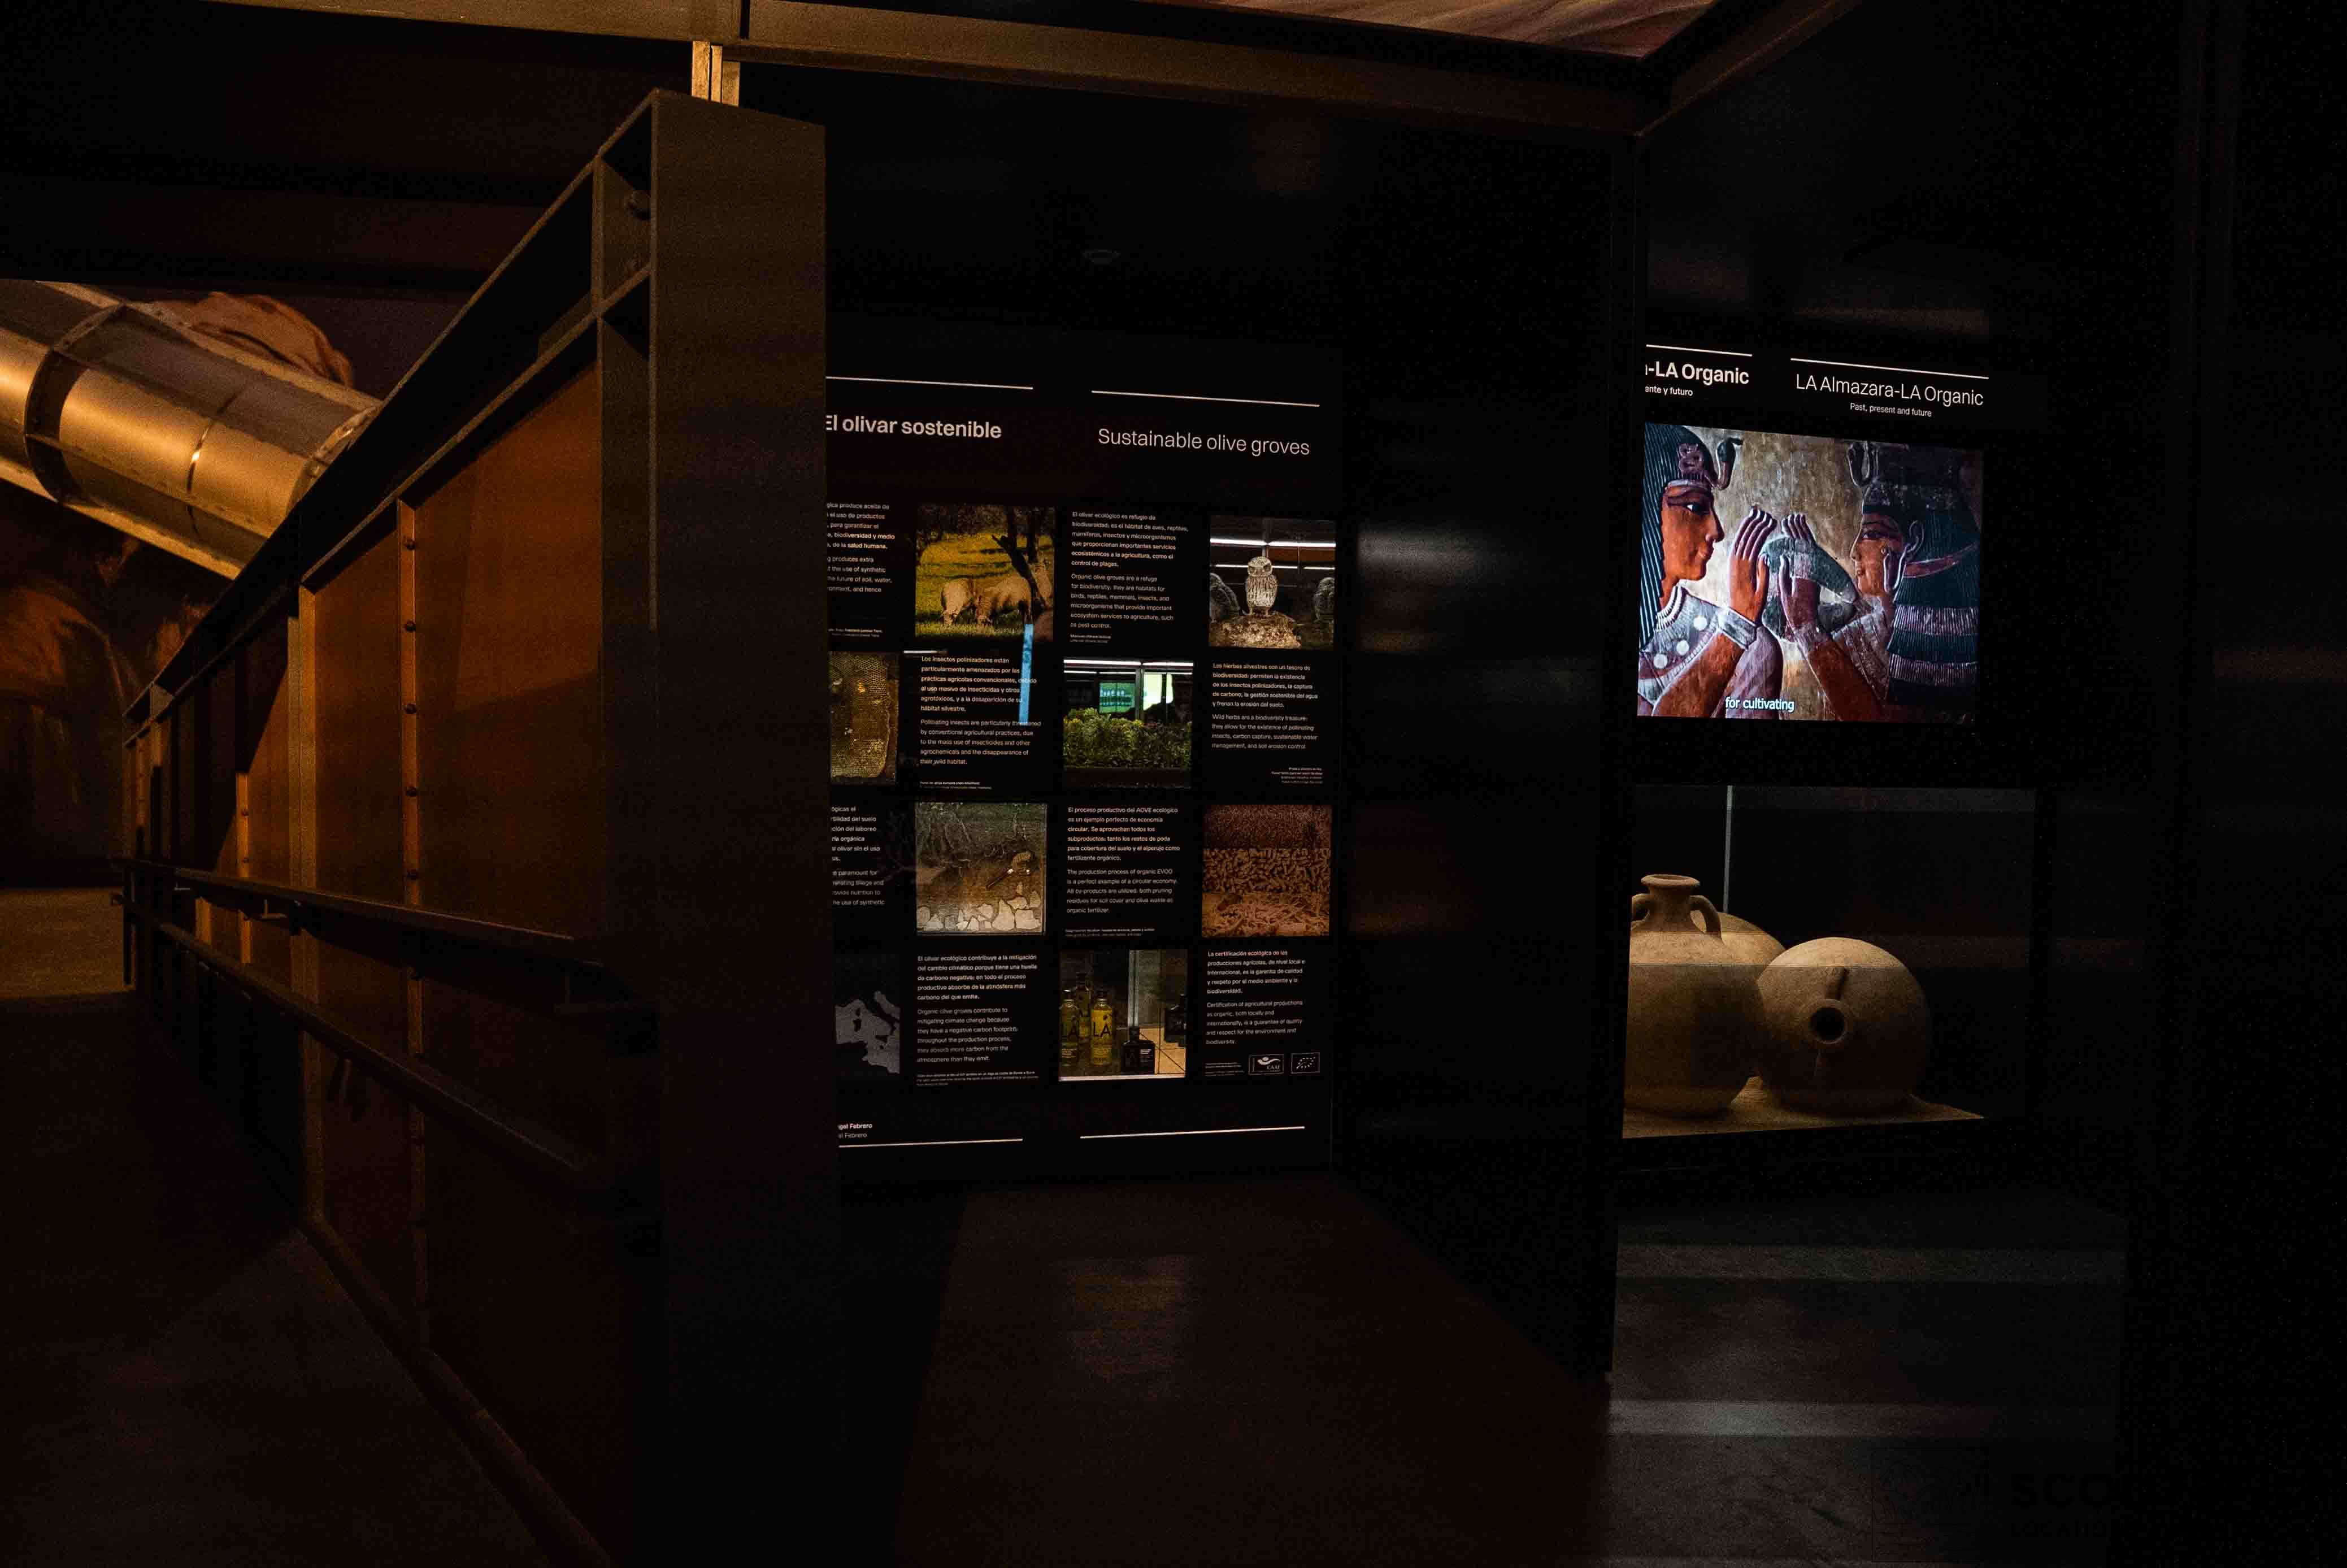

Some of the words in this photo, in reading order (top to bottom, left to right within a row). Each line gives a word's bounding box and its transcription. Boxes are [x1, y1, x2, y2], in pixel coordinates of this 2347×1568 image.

[1682, 363, 1750, 389] Organic
[1670, 387, 1694, 396] futuro
[1795, 374, 1816, 390] LA
[1820, 376, 1920, 399] Almazara-LA
[1925, 386, 1984, 410] Organic
[1850, 403, 1867, 411] Past,
[1870, 405, 1895, 414] present
[1912, 408, 1932, 417] future
[825, 414, 838, 431] El
[843, 415, 897, 433] olivar
[902, 418, 1003, 438] sostenible
[1098, 428, 1201, 449] Sustainable
[1207, 435, 1246, 451] olive
[1251, 440, 1311, 459] groves
[1726, 697, 1740, 709] for
[1743, 698, 1794, 713] cultivating
